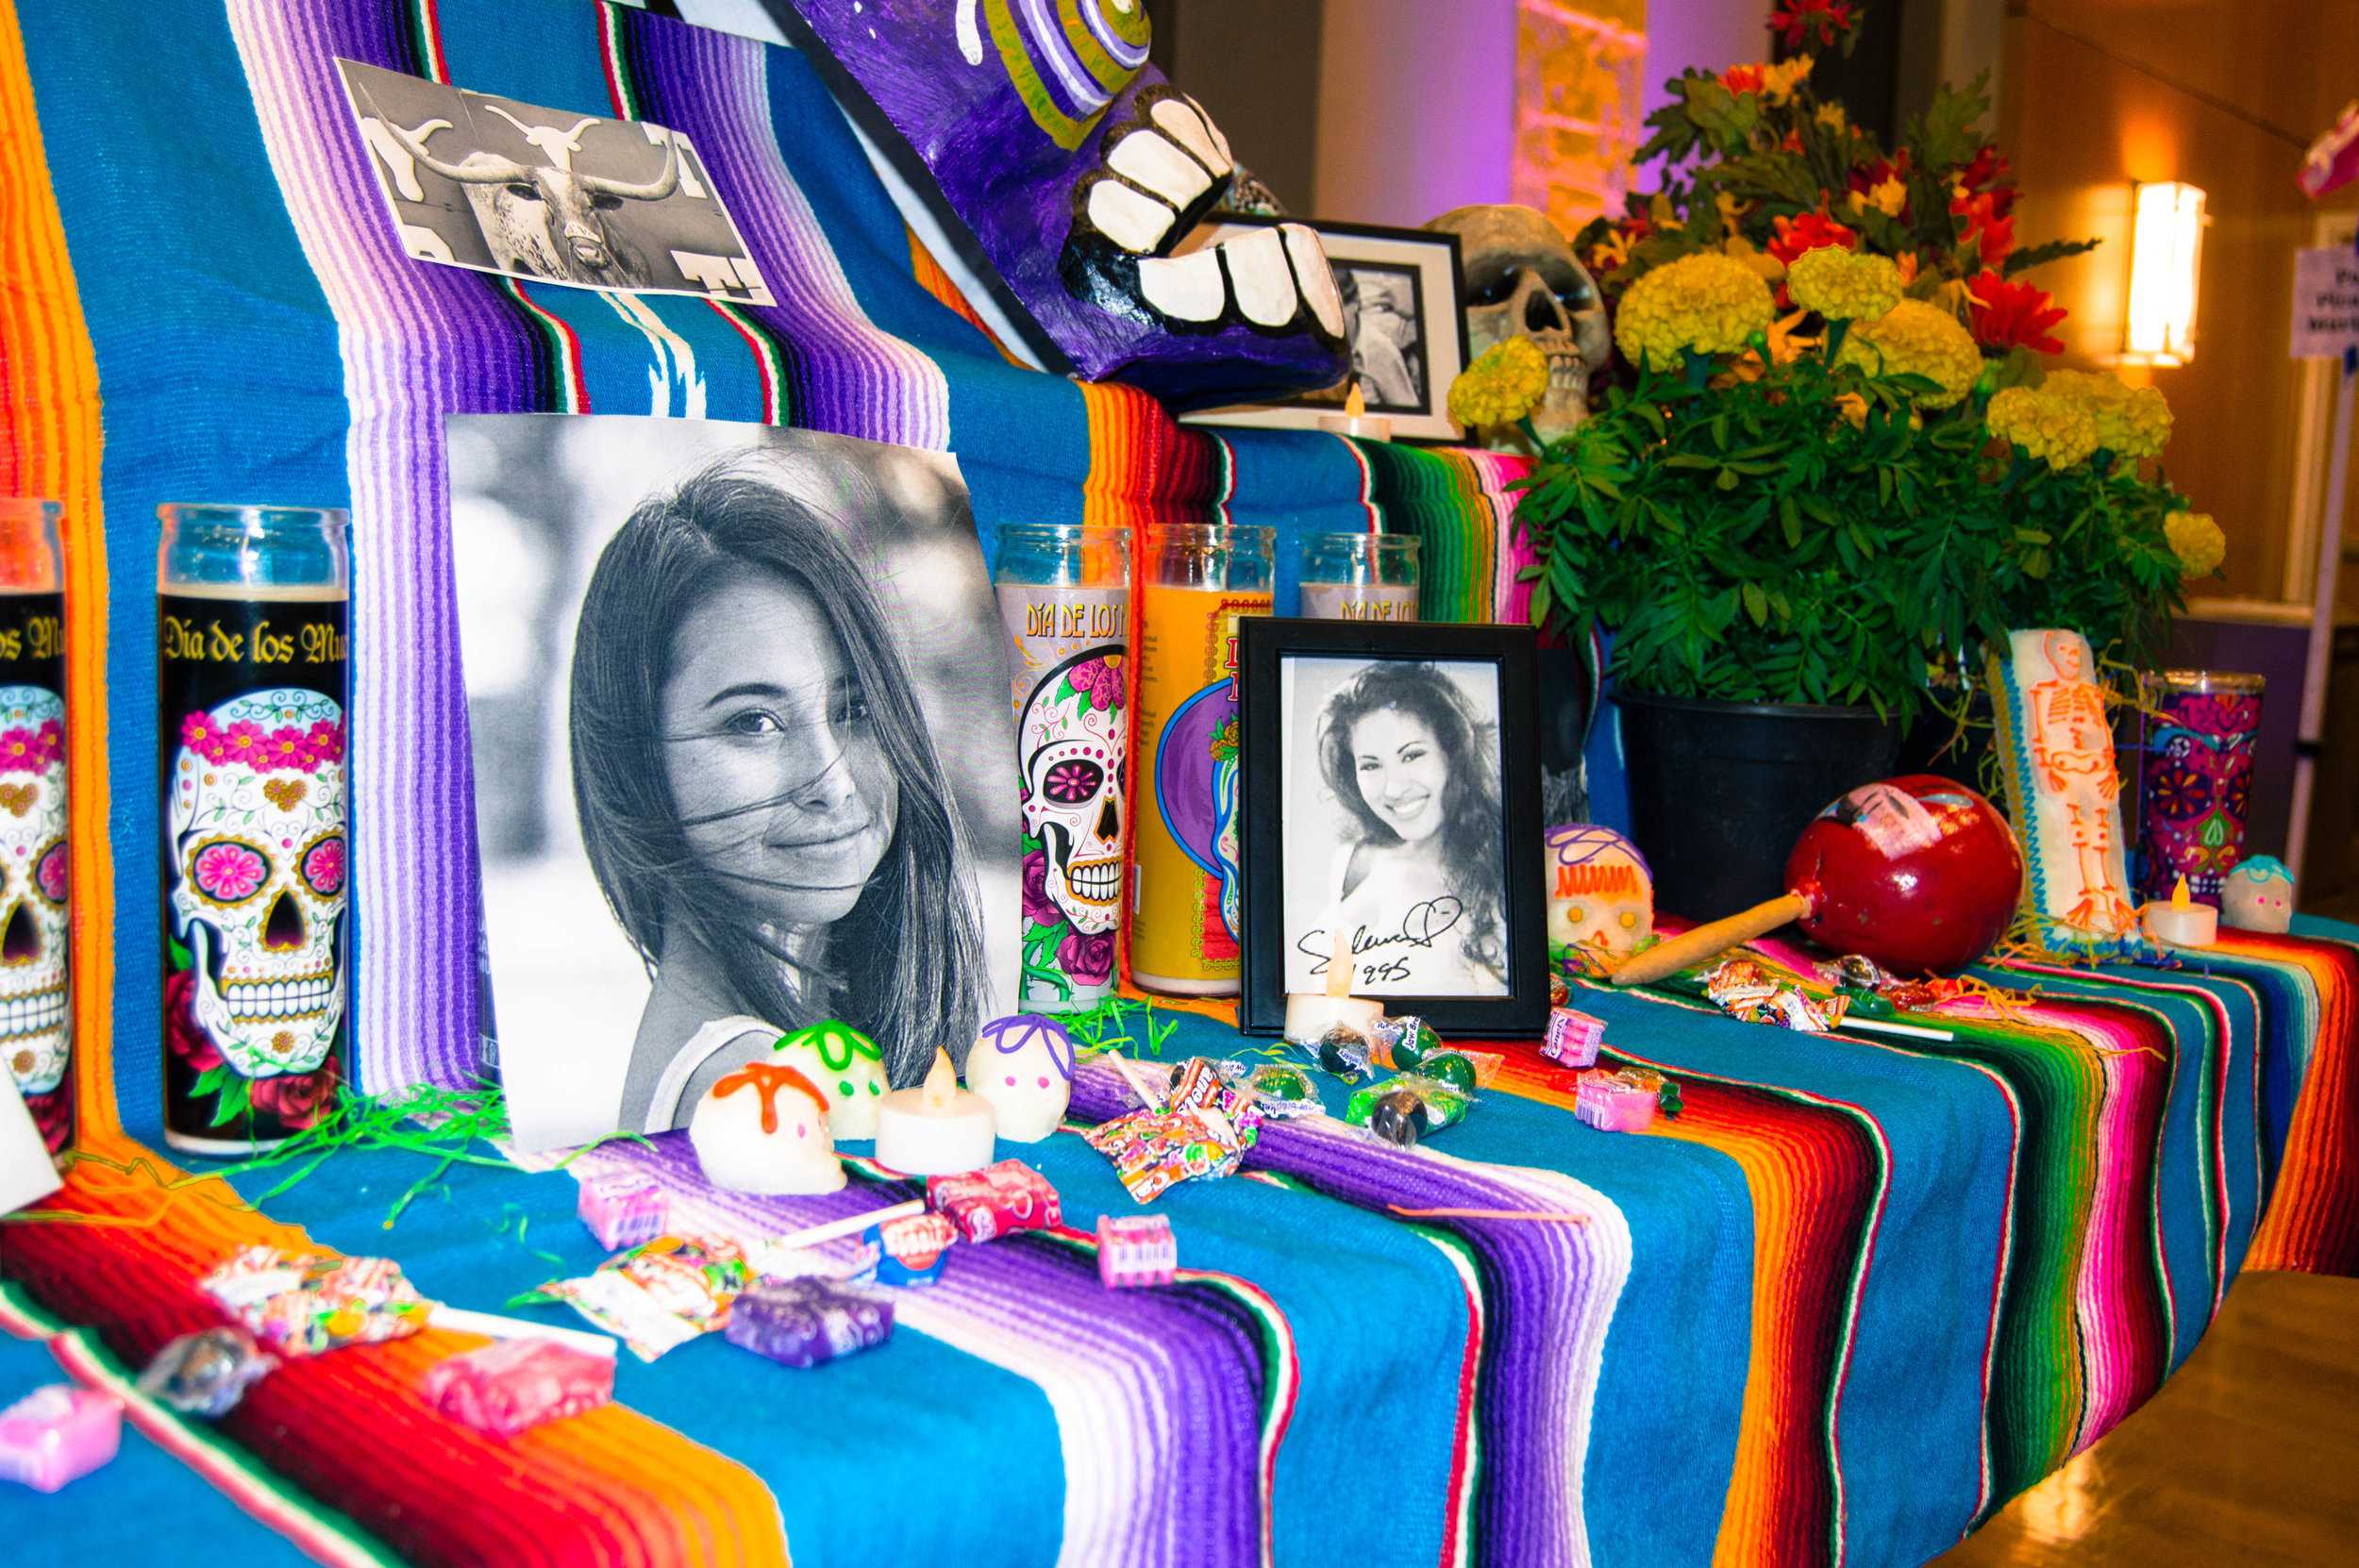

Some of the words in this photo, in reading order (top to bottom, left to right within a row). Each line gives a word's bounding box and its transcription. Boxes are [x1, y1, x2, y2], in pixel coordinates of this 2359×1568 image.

[1061, 603, 1085, 638] DE
[1090, 603, 1118, 638] LOS
[209, 619, 245, 662] de
[250, 620, 294, 663] los
